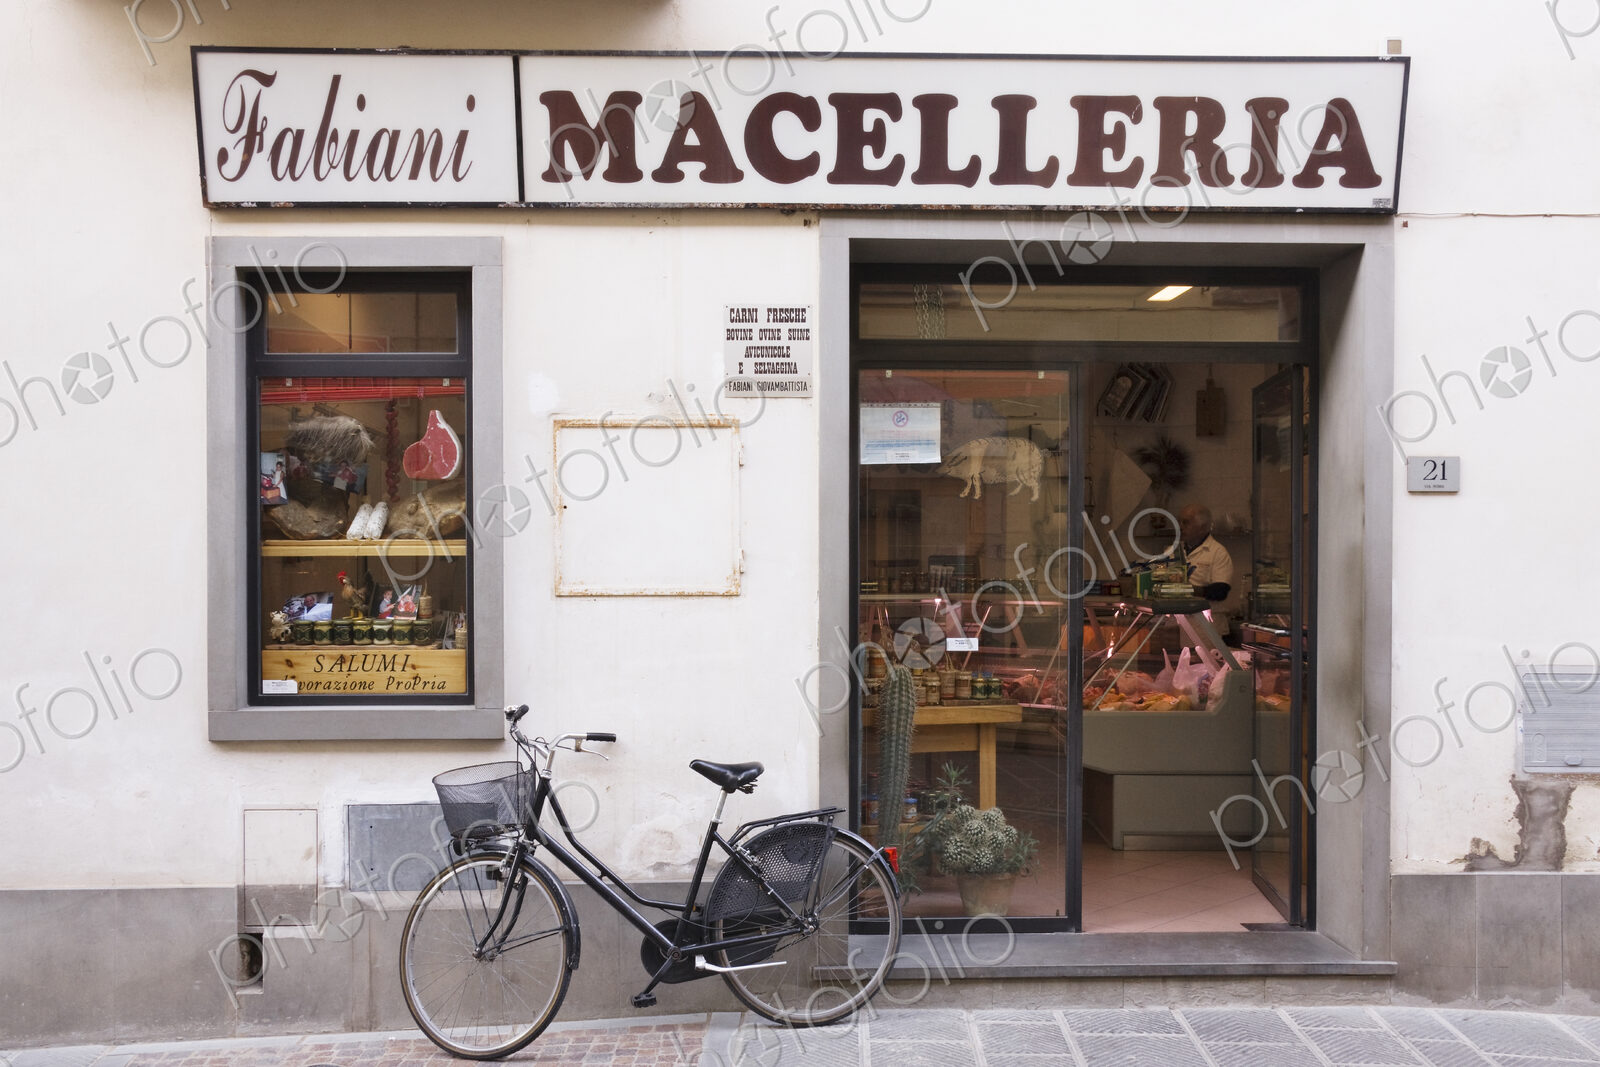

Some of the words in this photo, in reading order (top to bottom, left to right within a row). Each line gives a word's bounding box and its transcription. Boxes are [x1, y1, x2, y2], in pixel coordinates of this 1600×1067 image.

[217, 68, 478, 183] Fabiani
[539, 90, 1382, 189] MACELLERIA
[729, 307, 758, 323] CARNI
[767, 307, 807, 323] FRESCHE
[726, 328, 753, 341] BOVINE
[758, 328, 782, 341] OVINE
[787, 328, 810, 341] SUINE
[744, 345, 791, 358] AVICUNICOLE
[738, 361, 744, 374] E
[754, 361, 798, 374] SELVAGGINA
[728, 380, 753, 392] FABIANI
[757, 380, 808, 392] GIOVAMBATTISTA
[1422, 459, 1448, 481] 21
[313, 653, 411, 673] SALUMI
[281, 675, 375, 691] vorazione
